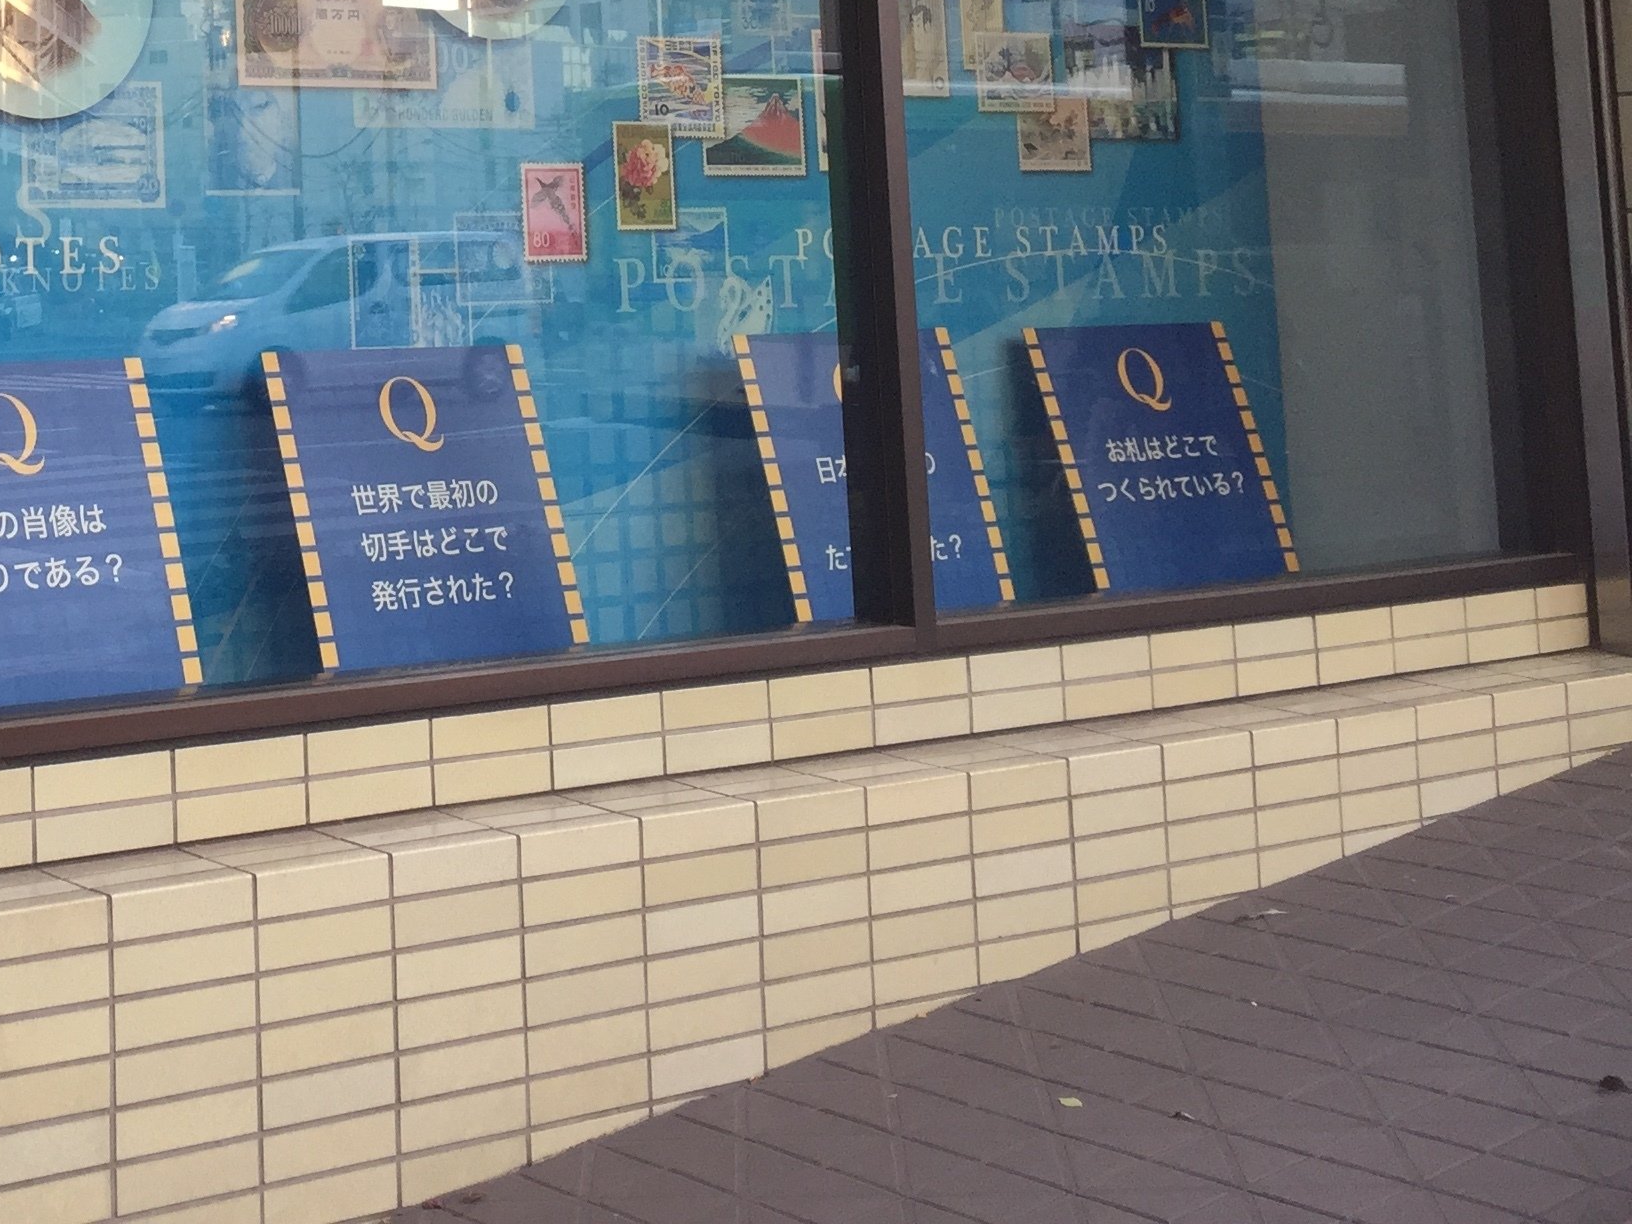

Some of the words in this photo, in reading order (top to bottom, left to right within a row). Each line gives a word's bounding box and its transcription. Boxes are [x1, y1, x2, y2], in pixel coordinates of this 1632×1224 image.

[654, 103, 670, 116] 10
[533, 231, 550, 248] 80
[1016, 224, 1170, 257] STAMPS
[1116, 347, 1174, 413] Q
[377, 376, 445, 454] Q
[1104, 434, 1220, 465] お札はどこで
[350, 478, 499, 518] 世界で最初の
[360, 525, 508, 565] 切手はどこで
